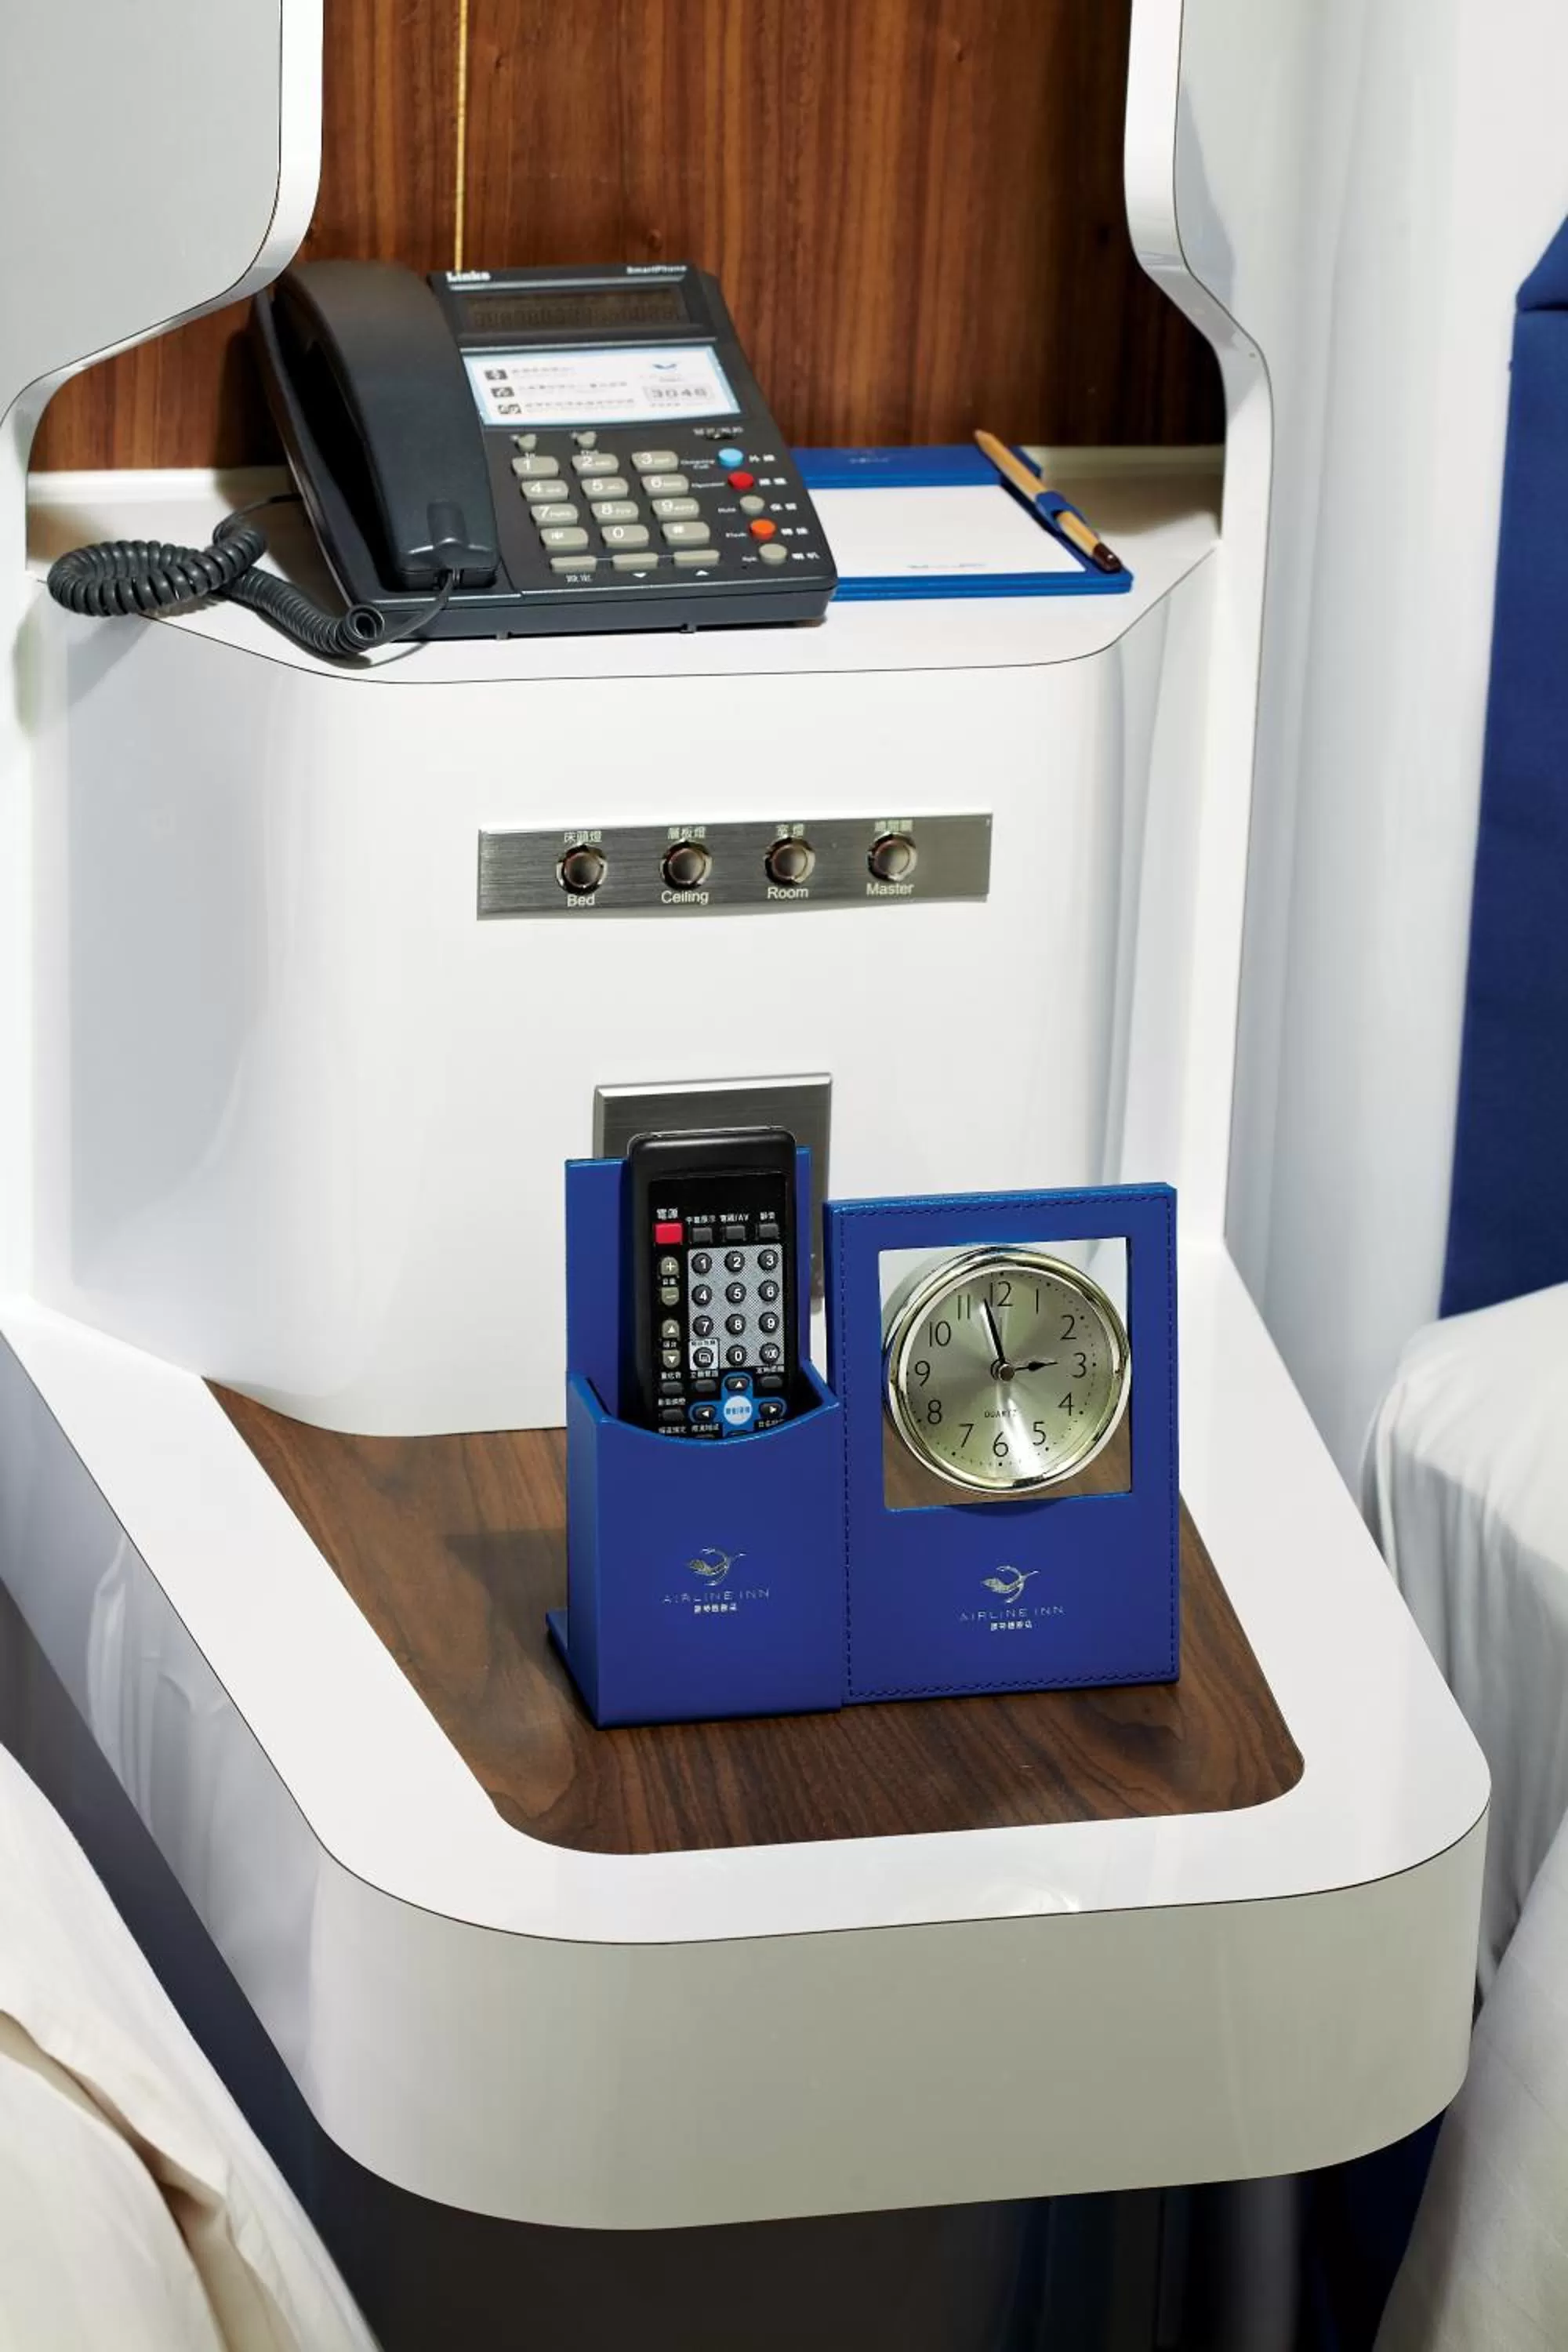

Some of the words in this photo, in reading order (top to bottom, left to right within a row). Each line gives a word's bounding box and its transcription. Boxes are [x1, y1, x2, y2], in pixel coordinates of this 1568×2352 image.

[530, 481, 542, 494] 4
[539, 506, 551, 519] 7
[601, 503, 612, 516] 8
[661, 499, 673, 513] 9
[567, 894, 595, 907] Bed
[661, 890, 710, 904] Ceiling
[767, 886, 809, 899] Room
[866, 883, 915, 895] Master
[989, 1280, 1014, 1308] 12
[957, 1294, 971, 1320] 11
[929, 1320, 952, 1348] 10
[1060, 1314, 1076, 1340] 2
[914, 1360, 931, 1387] 9
[1071, 1352, 1087, 1378] 3
[927, 1399, 942, 1425] 8
[1058, 1392, 1075, 1416] 4
[958, 1423, 975, 1448] 7
[993, 1432, 1009, 1457] 6
[1032, 1421, 1047, 1446] 5
[663, 1590, 734, 1604] AIRLINE
[739, 1588, 770, 1600] INN
[960, 1608, 1029, 1621] AIRLINE
[1034, 1606, 1066, 1616] INN
